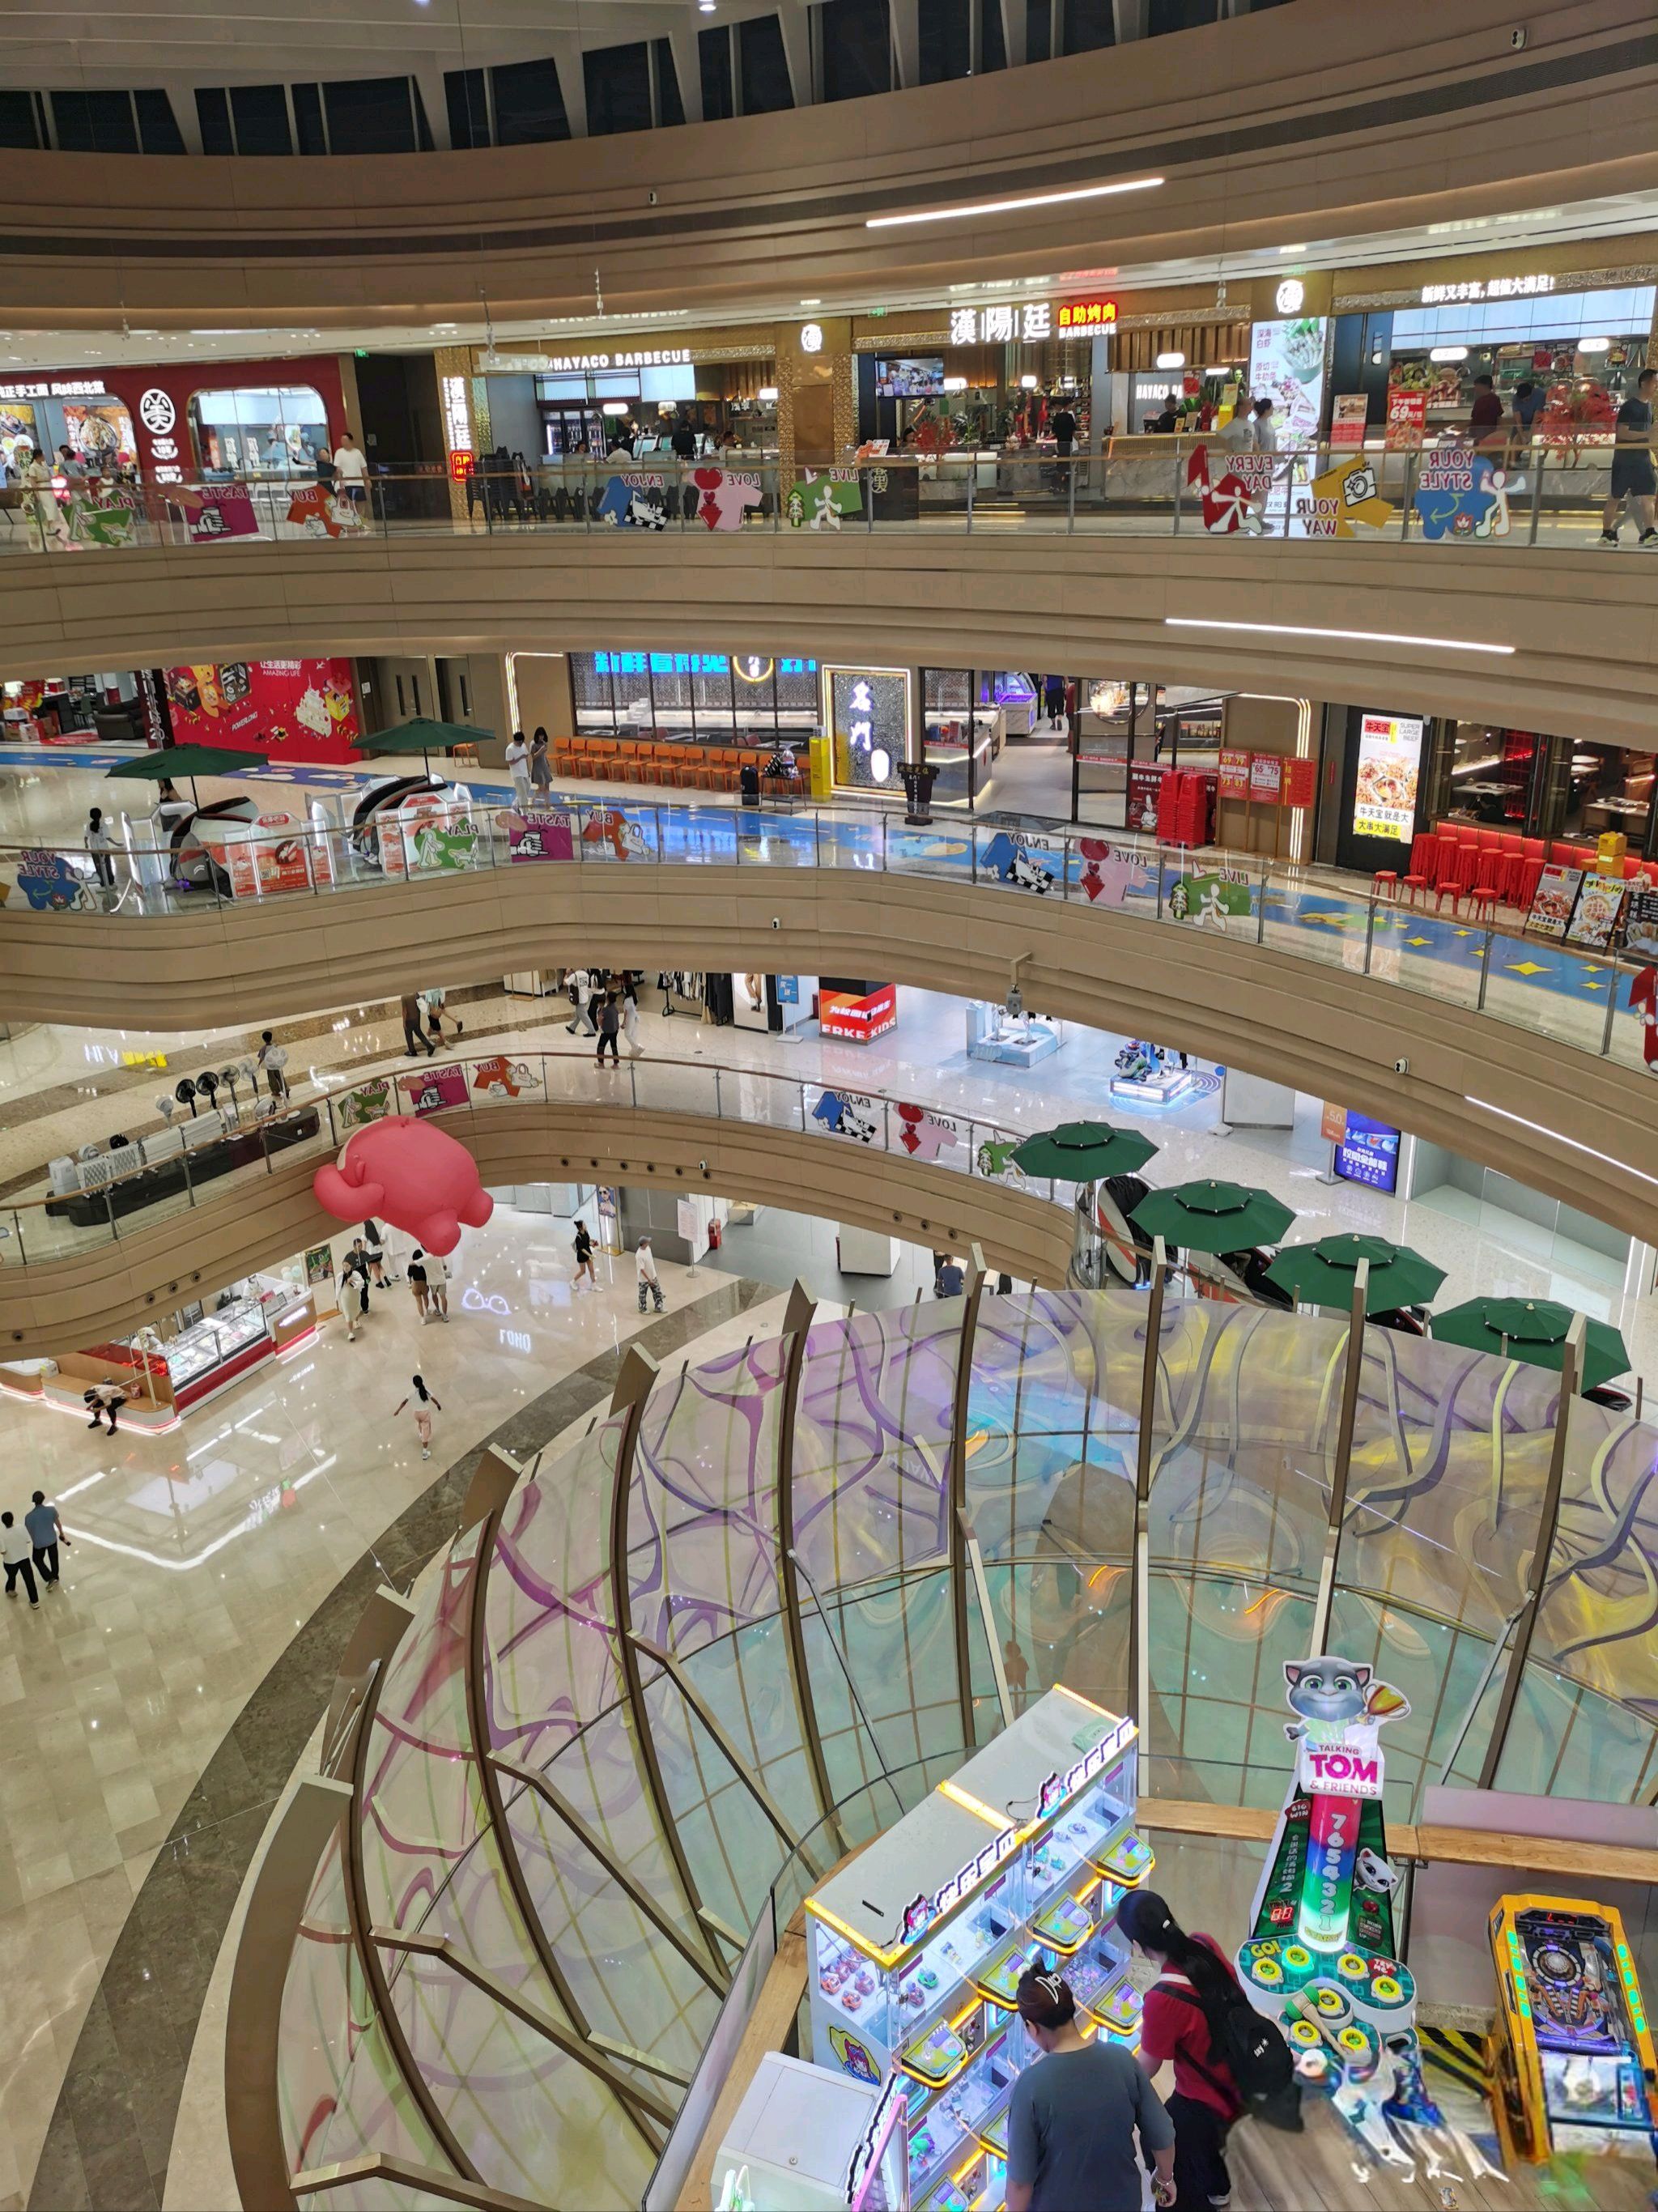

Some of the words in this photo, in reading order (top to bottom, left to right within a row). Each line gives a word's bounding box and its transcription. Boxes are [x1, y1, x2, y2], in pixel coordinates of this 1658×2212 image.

[1059, 323, 1116, 339] BARBECUE
[615, 349, 690, 366] BARBECUE
[262, 669, 288, 677] AMAZING
[1359, 806, 1409, 823] 牛天宝就是大
[821, 1023, 865, 1040] ERKE
[1318, 1744, 1360, 1755] TALKING
[1309, 1754, 1378, 1784] TOM
[1309, 1780, 1319, 1790] &
[1323, 1780, 1378, 1796] FRIENDS
[1331, 1813, 1346, 1830] 7
[1327, 1831, 1344, 1848] 6
[1326, 1848, 1341, 1865] 5
[1322, 1865, 1341, 1882] 4
[1321, 1882, 1337, 1897] 3
[1320, 1901, 1336, 1916] 2
[1250, 1940, 1282, 1959] GO!
